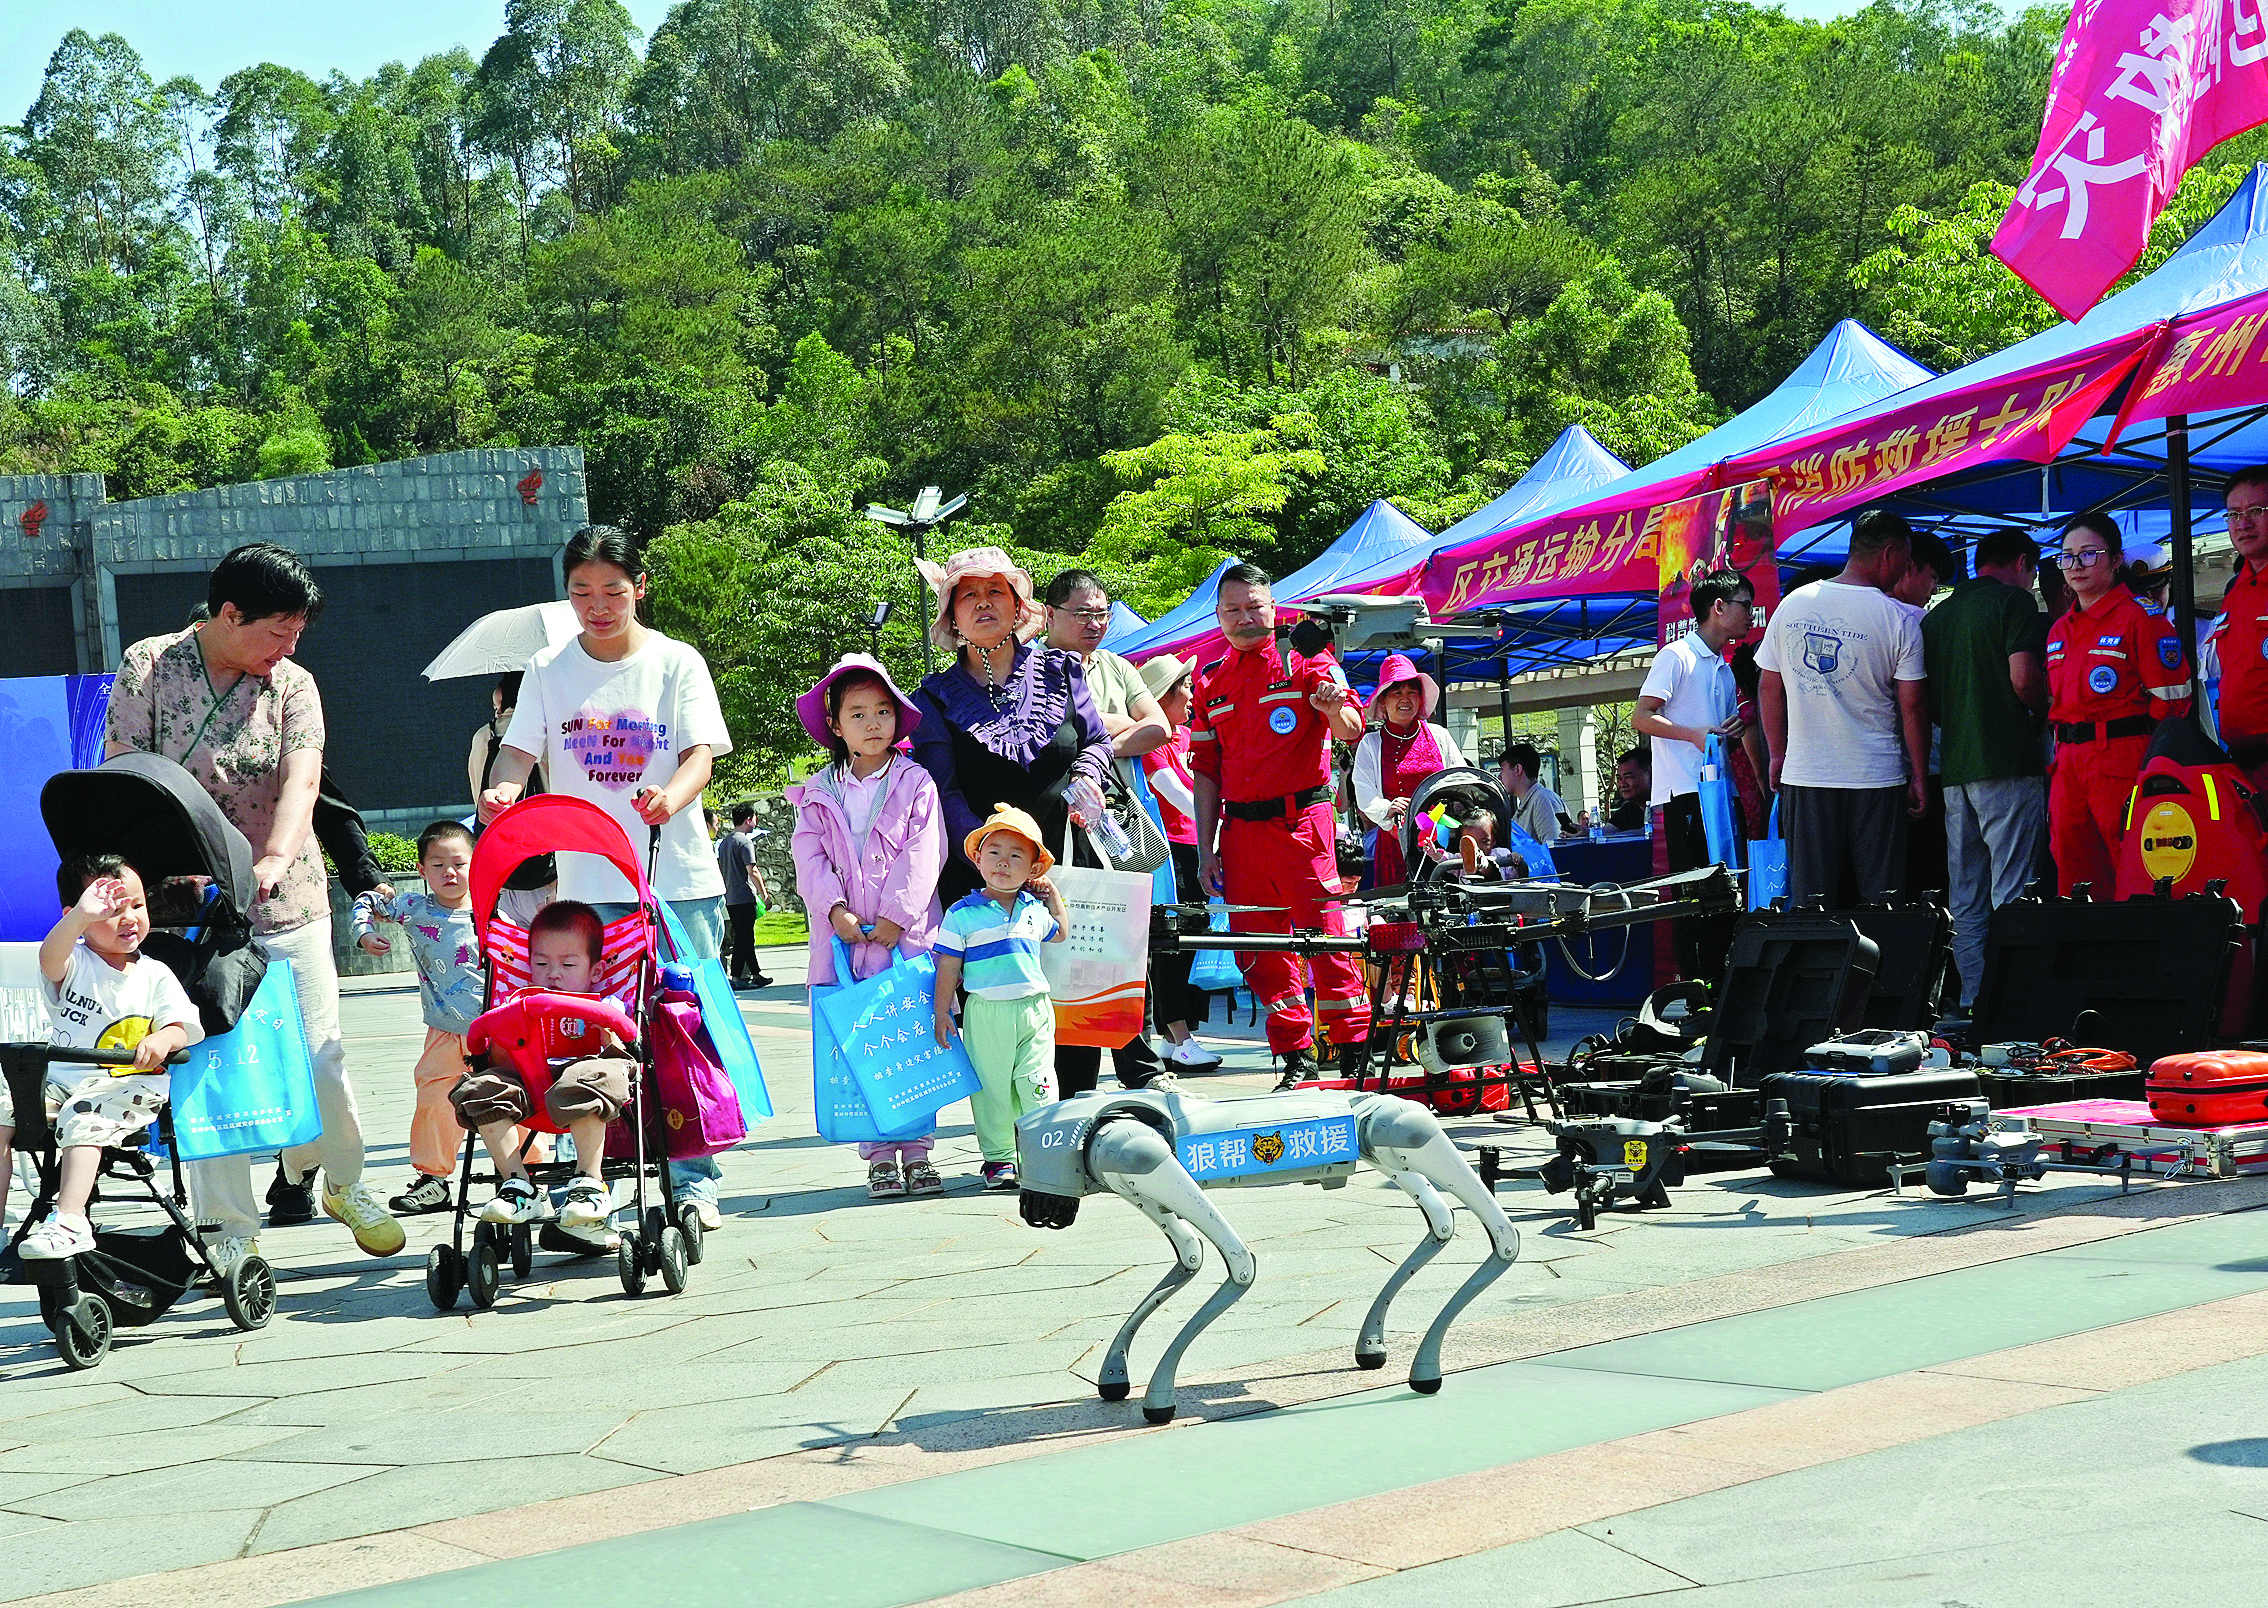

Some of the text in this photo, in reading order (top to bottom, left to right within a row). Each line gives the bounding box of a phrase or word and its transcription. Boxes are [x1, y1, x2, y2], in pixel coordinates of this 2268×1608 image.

[2137, 309, 2268, 403] 惠州
[1438, 506, 1663, 614] 区交通运输分局
[1785, 622, 1868, 641] SOUTHERN TIDE
[561, 718, 583, 735] SUN
[587, 718, 612, 730] For
[602, 735, 626, 747] For
[584, 751, 612, 765] And
[588, 769, 643, 783] Forever
[66, 988, 104, 1015] LNUT
[852, 990, 932, 1034] 人人讲安全
[208, 1044, 259, 1069] 5.12
[873, 1044, 953, 1081] 排查身边灾害隐
[1041, 1130, 1063, 1149] 02
[1187, 1122, 1350, 1173] 狼帮 救援
